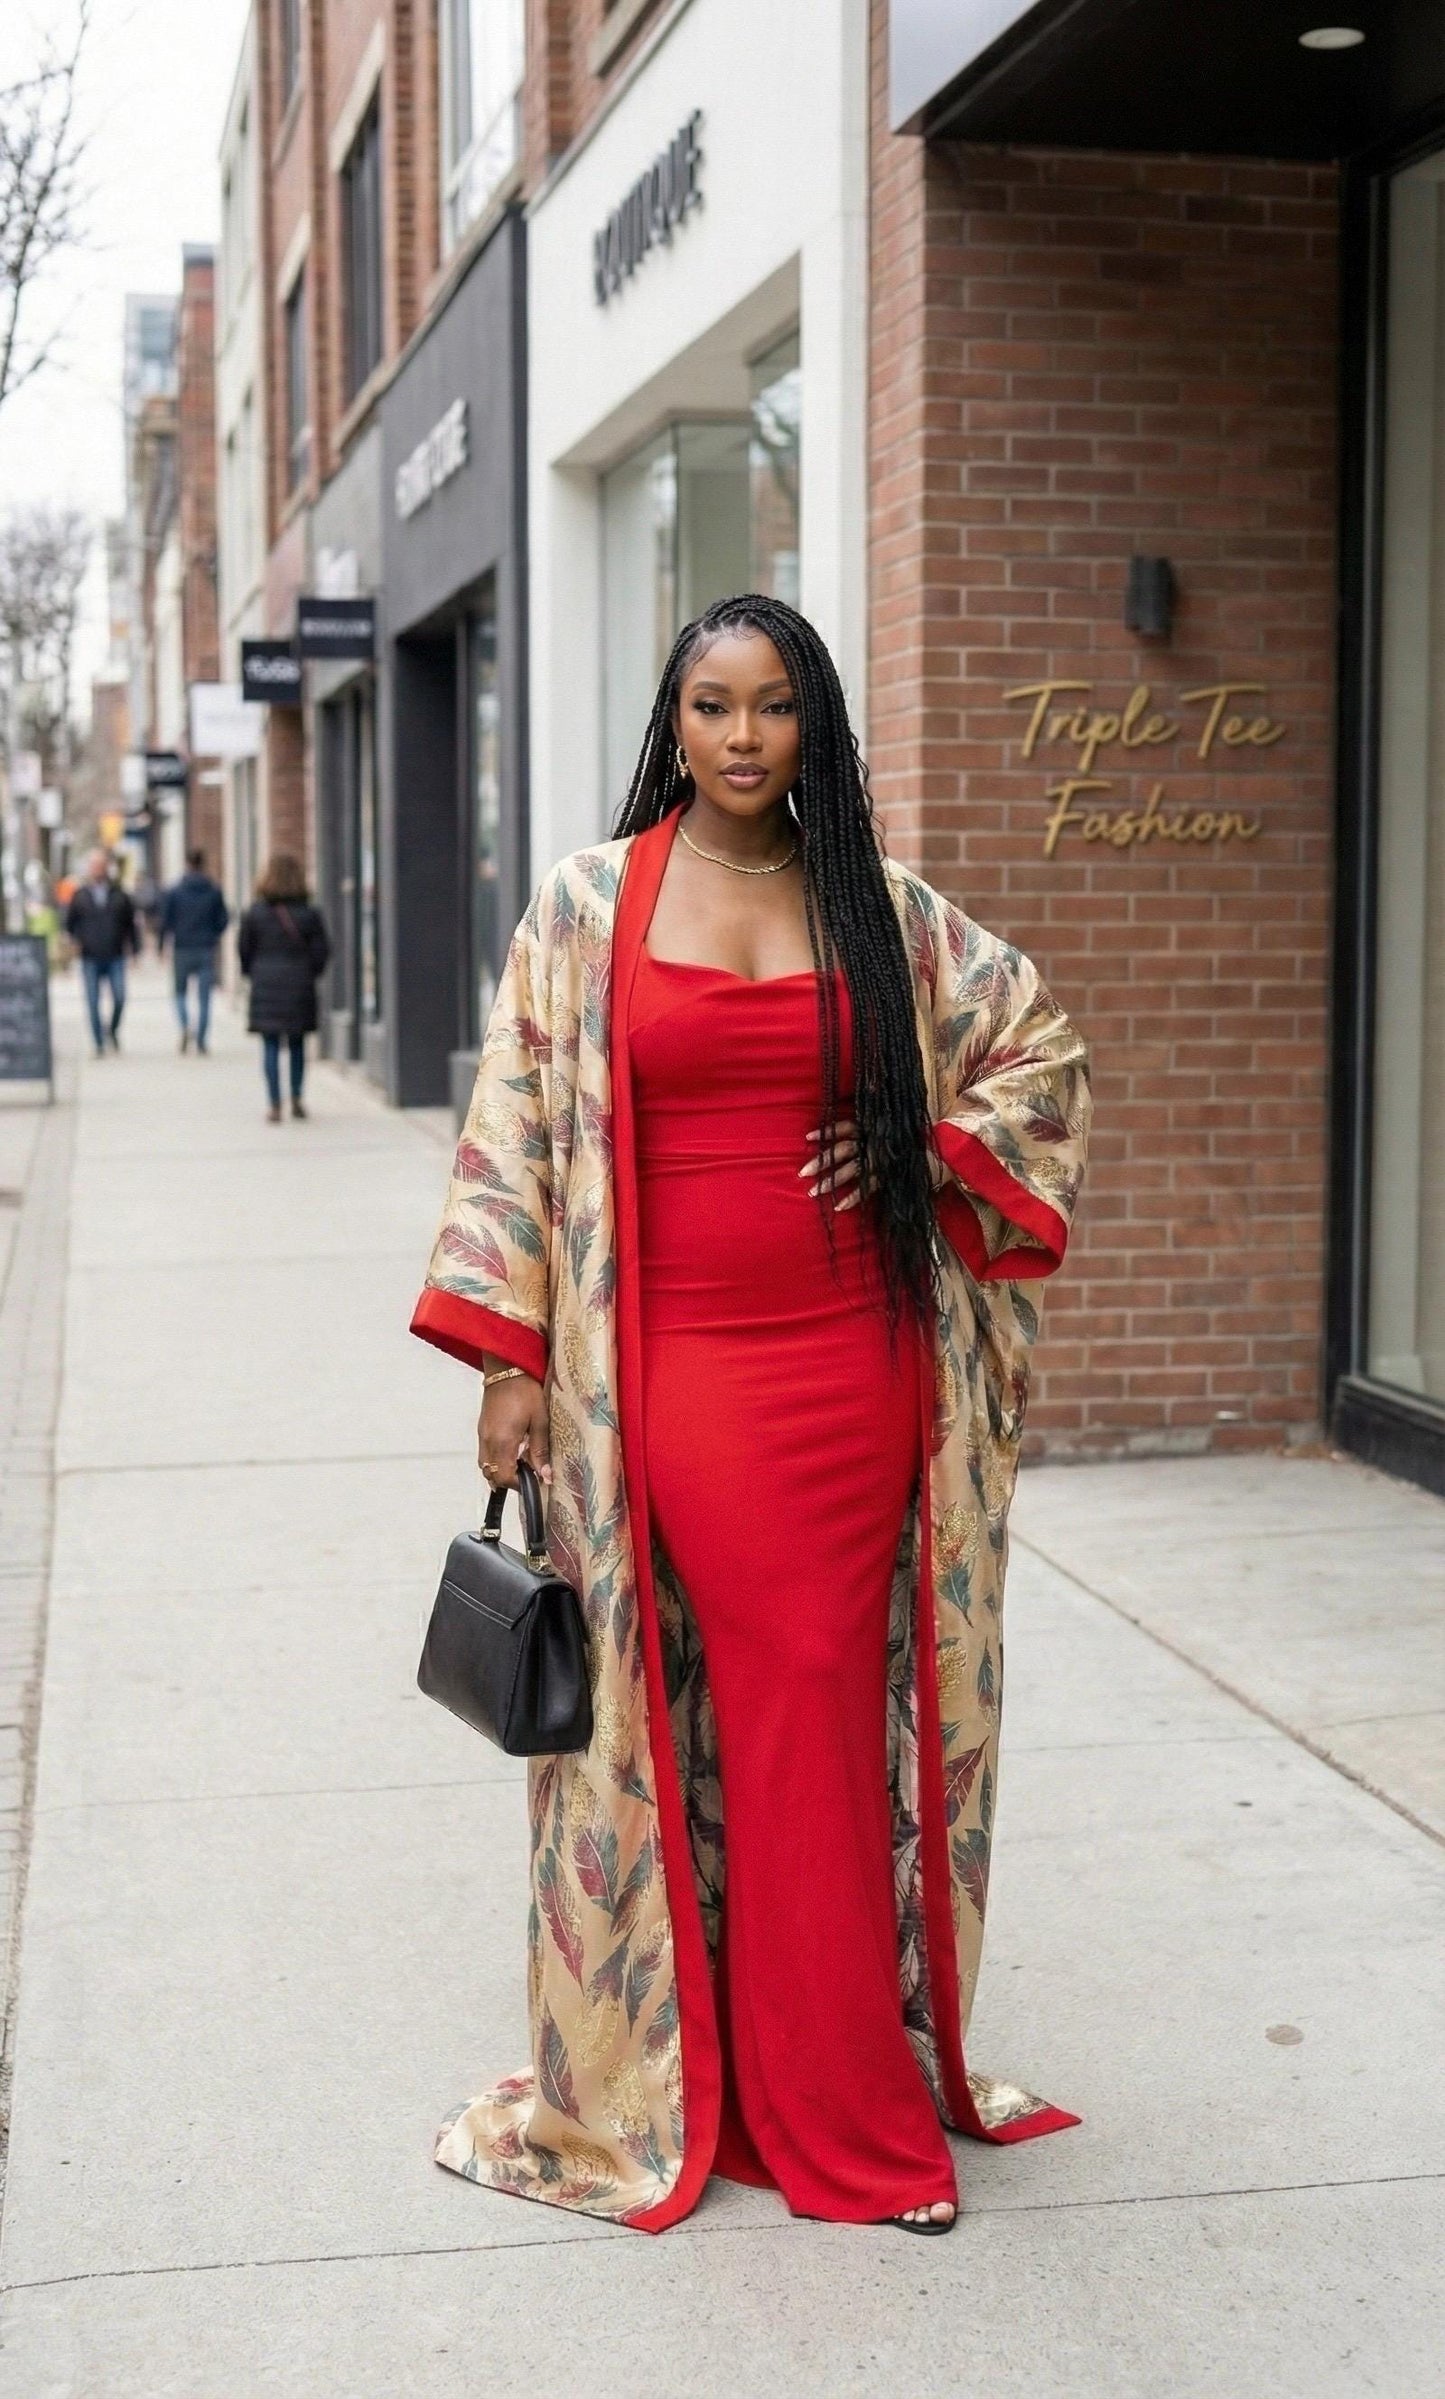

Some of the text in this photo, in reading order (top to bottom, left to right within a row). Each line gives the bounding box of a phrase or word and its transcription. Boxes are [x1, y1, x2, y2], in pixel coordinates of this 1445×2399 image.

[1002, 680, 1286, 773] Triple Tee
[1044, 779, 1261, 857] Fashion
